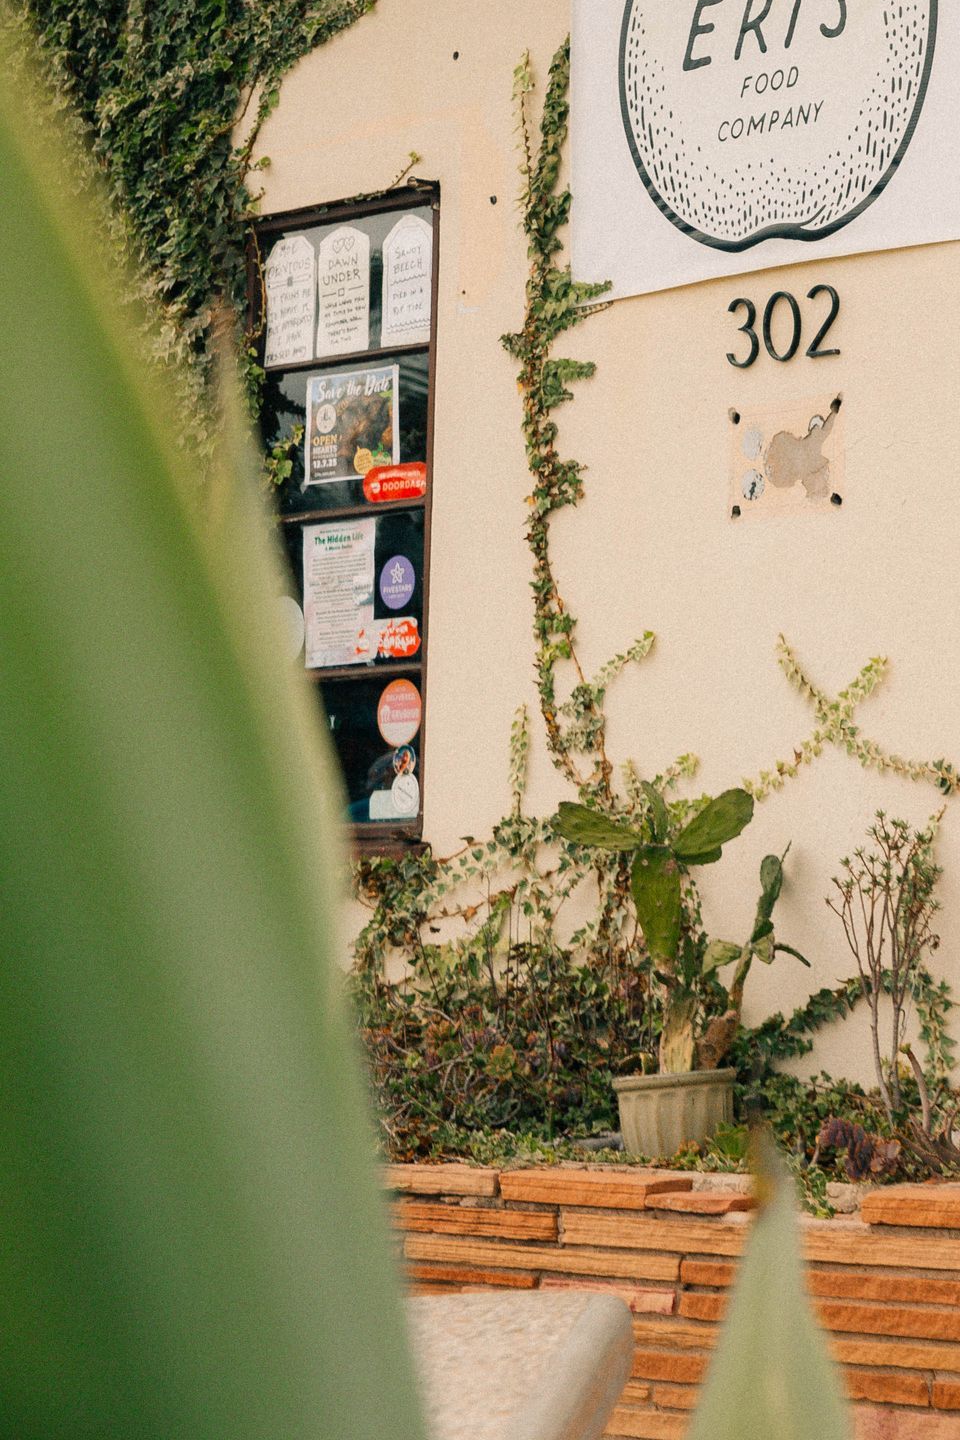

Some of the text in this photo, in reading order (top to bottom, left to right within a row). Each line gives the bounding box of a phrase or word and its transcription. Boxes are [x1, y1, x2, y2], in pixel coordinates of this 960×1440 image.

[740, 66, 799, 98] FOOD
[717, 100, 824, 142] COMPANY
[328, 253, 358, 270] DAWN
[322, 268, 361, 286] UNDER
[726, 284, 841, 369] 302
[317, 373, 394, 403] Save the Date
[312, 433, 338, 447] OPEN
[327, 534, 351, 544] Hidden
